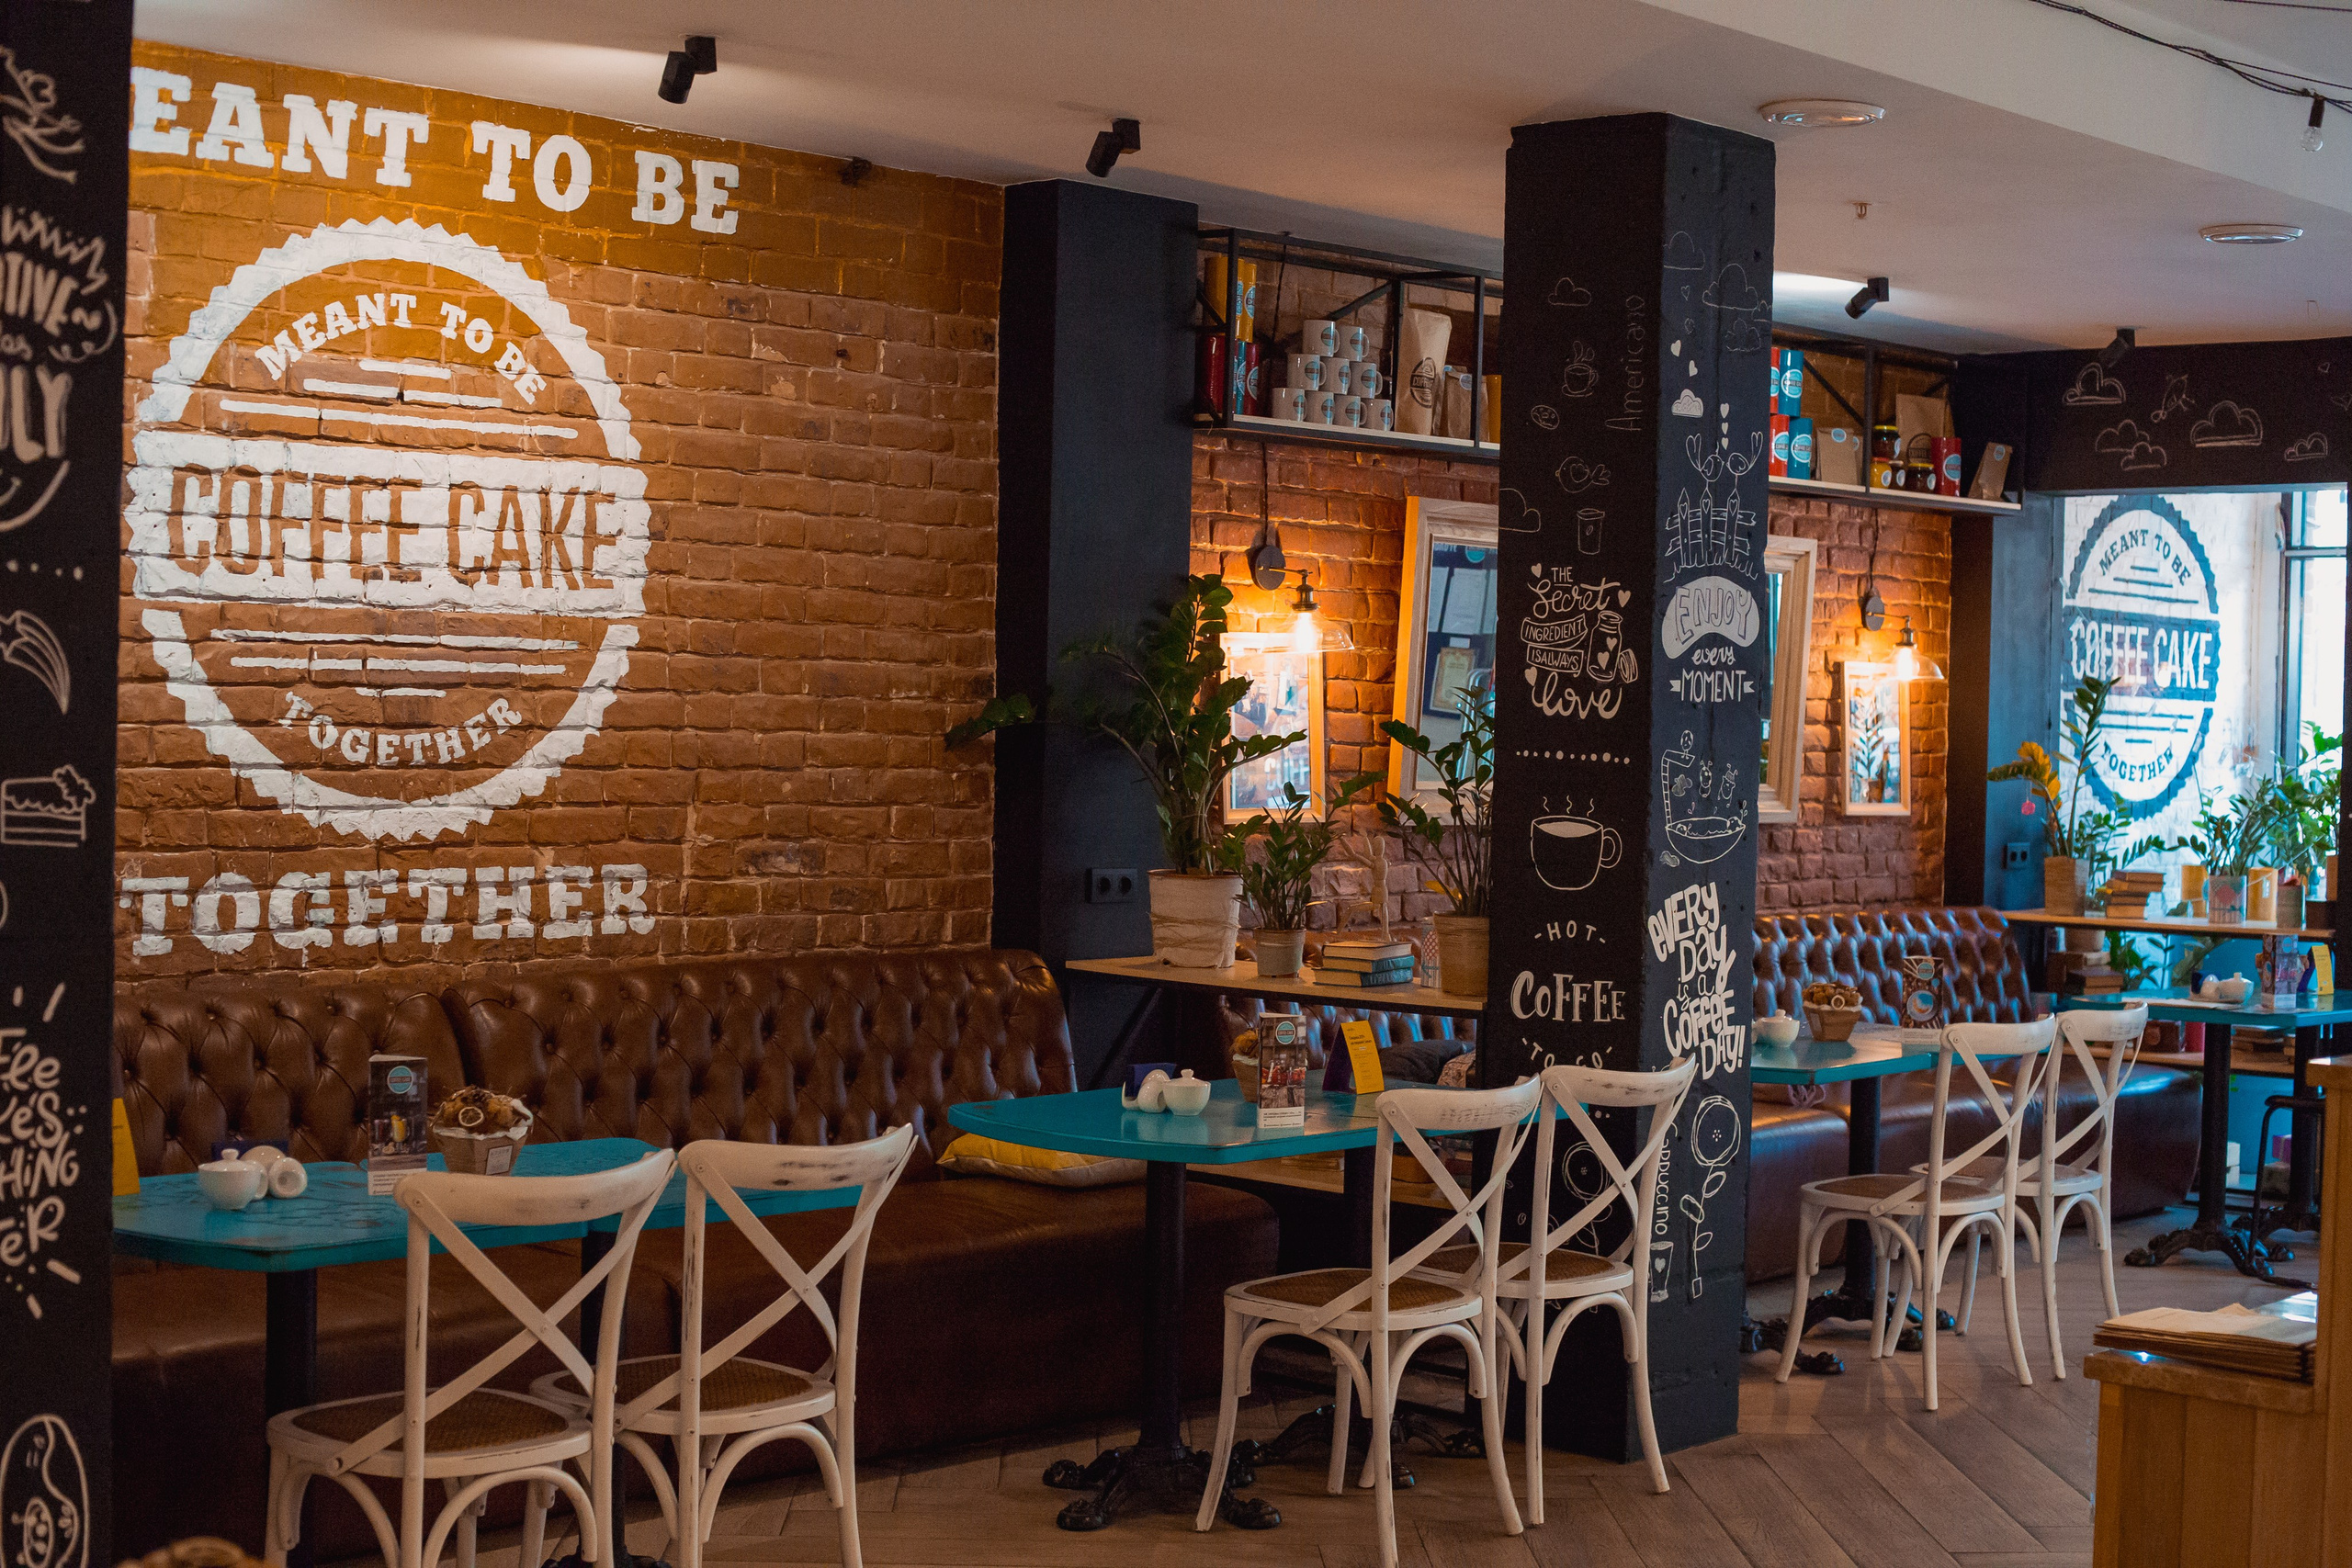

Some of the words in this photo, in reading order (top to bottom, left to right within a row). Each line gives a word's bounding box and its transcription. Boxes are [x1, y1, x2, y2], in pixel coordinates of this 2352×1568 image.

[472, 120, 593, 212] TO
[632, 150, 739, 235] BE
[254, 293, 416, 380] MEANT
[440, 301, 494, 354] TO
[493, 341, 548, 405] BE
[1604, 295, 1645, 431] Americano
[169, 462, 424, 584] COFFEE
[447, 479, 619, 592] CAKE
[1551, 566, 1574, 582] THE
[2099, 529, 2149, 576] MEANT
[2154, 534, 2171, 560] TO
[2171, 554, 2191, 586] BE
[1527, 577, 1622, 619] Secret
[1675, 585, 1752, 646] ENJOY
[1524, 618, 1583, 642] INGREDIENT
[2070, 620, 2150, 688] COFFEE
[2153, 627, 2213, 690] CAKE
[1532, 671, 1623, 719] love
[1680, 668, 1747, 703] MOMENT
[278, 691, 523, 768] TOGETHER
[2101, 740, 2174, 783] TOGETHER
[120, 863, 657, 957] TOGETHER
[1530, 1042, 1555, 1068] TO
